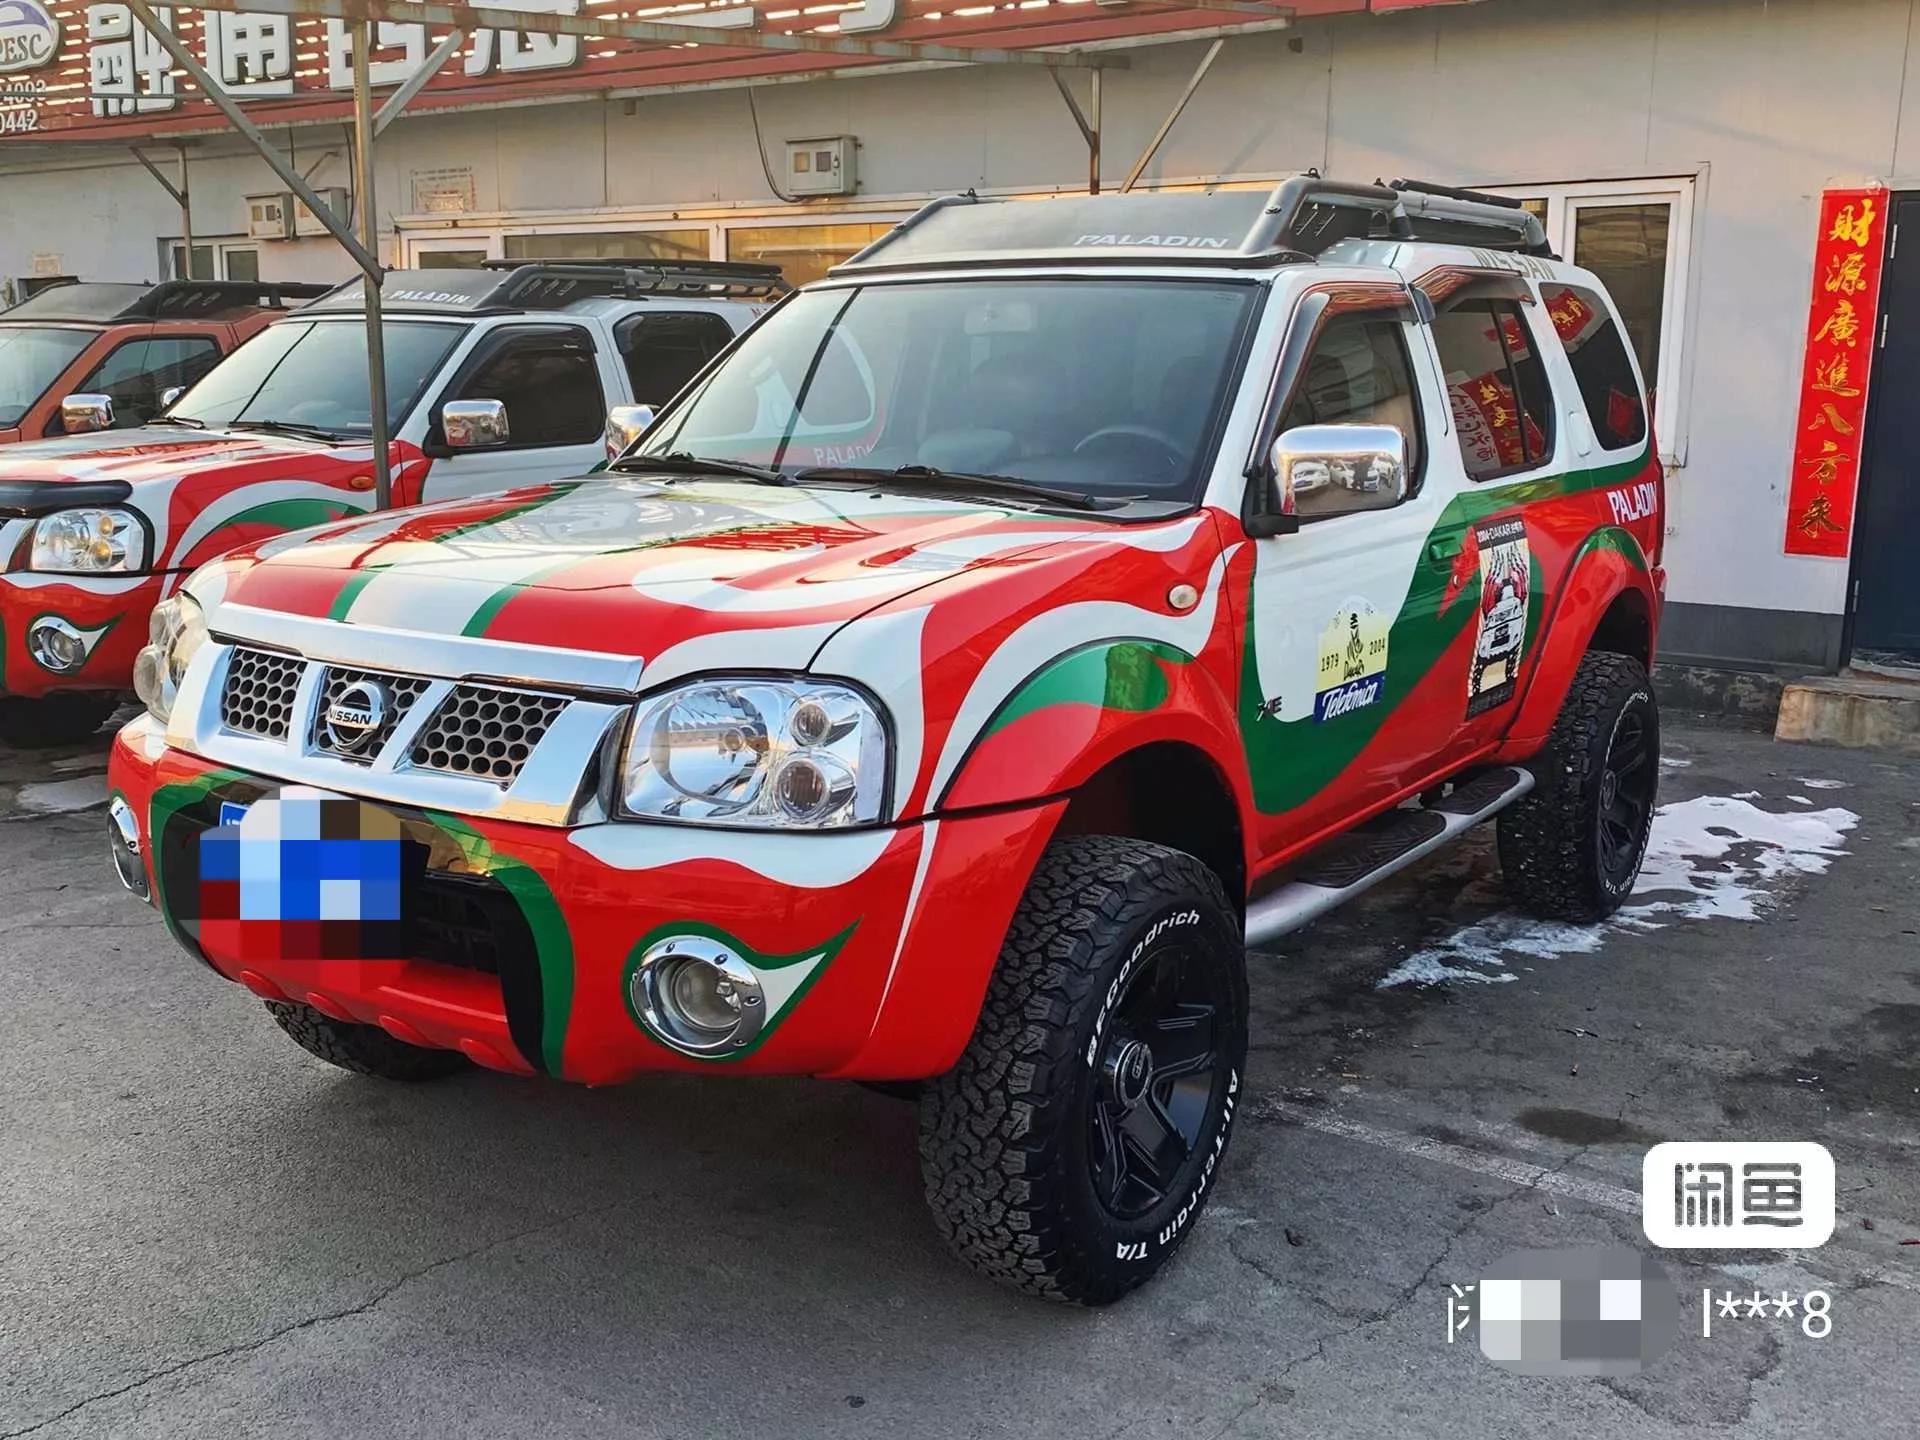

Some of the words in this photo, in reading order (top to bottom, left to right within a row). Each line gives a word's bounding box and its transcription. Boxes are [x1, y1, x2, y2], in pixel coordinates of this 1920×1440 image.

[1073, 234, 1230, 248] PALADIN
[389, 289, 471, 305] PALADIN
[1607, 481, 1658, 525] PALADIN
[1321, 652, 1340, 672] 1979
[1369, 637, 1386, 656] 2004
[329, 709, 372, 725] NISSAN
[1116, 1241, 1148, 1261] T/A
